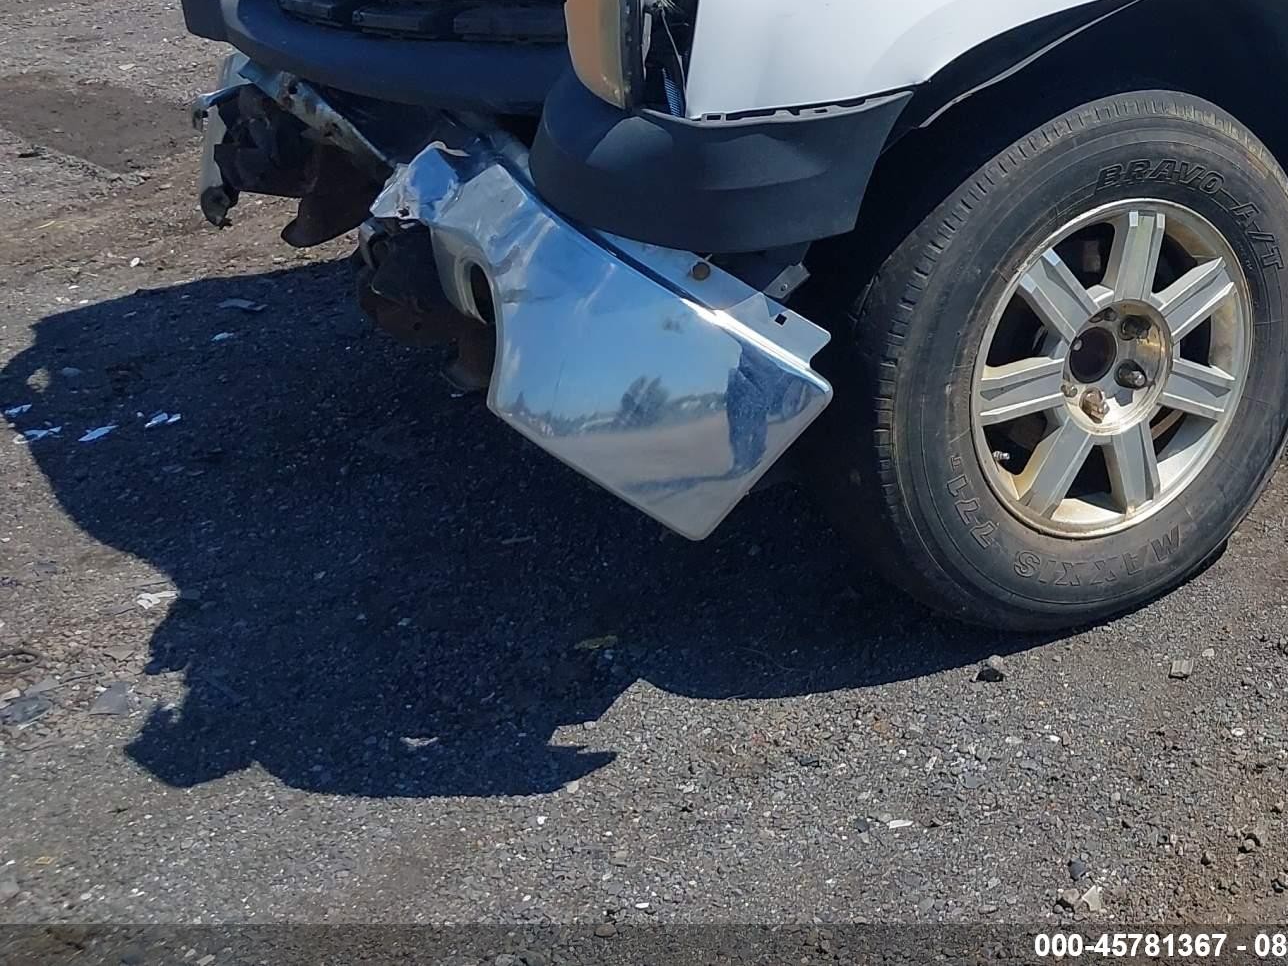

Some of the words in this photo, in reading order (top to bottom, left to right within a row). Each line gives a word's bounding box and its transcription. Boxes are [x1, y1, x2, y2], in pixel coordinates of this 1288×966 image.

[1096, 158, 1225, 195] BRAVO
[1230, 201, 1285, 270] A/T
[946, 474, 997, 549] 771
[1013, 522, 1182, 587] MAXXIS
